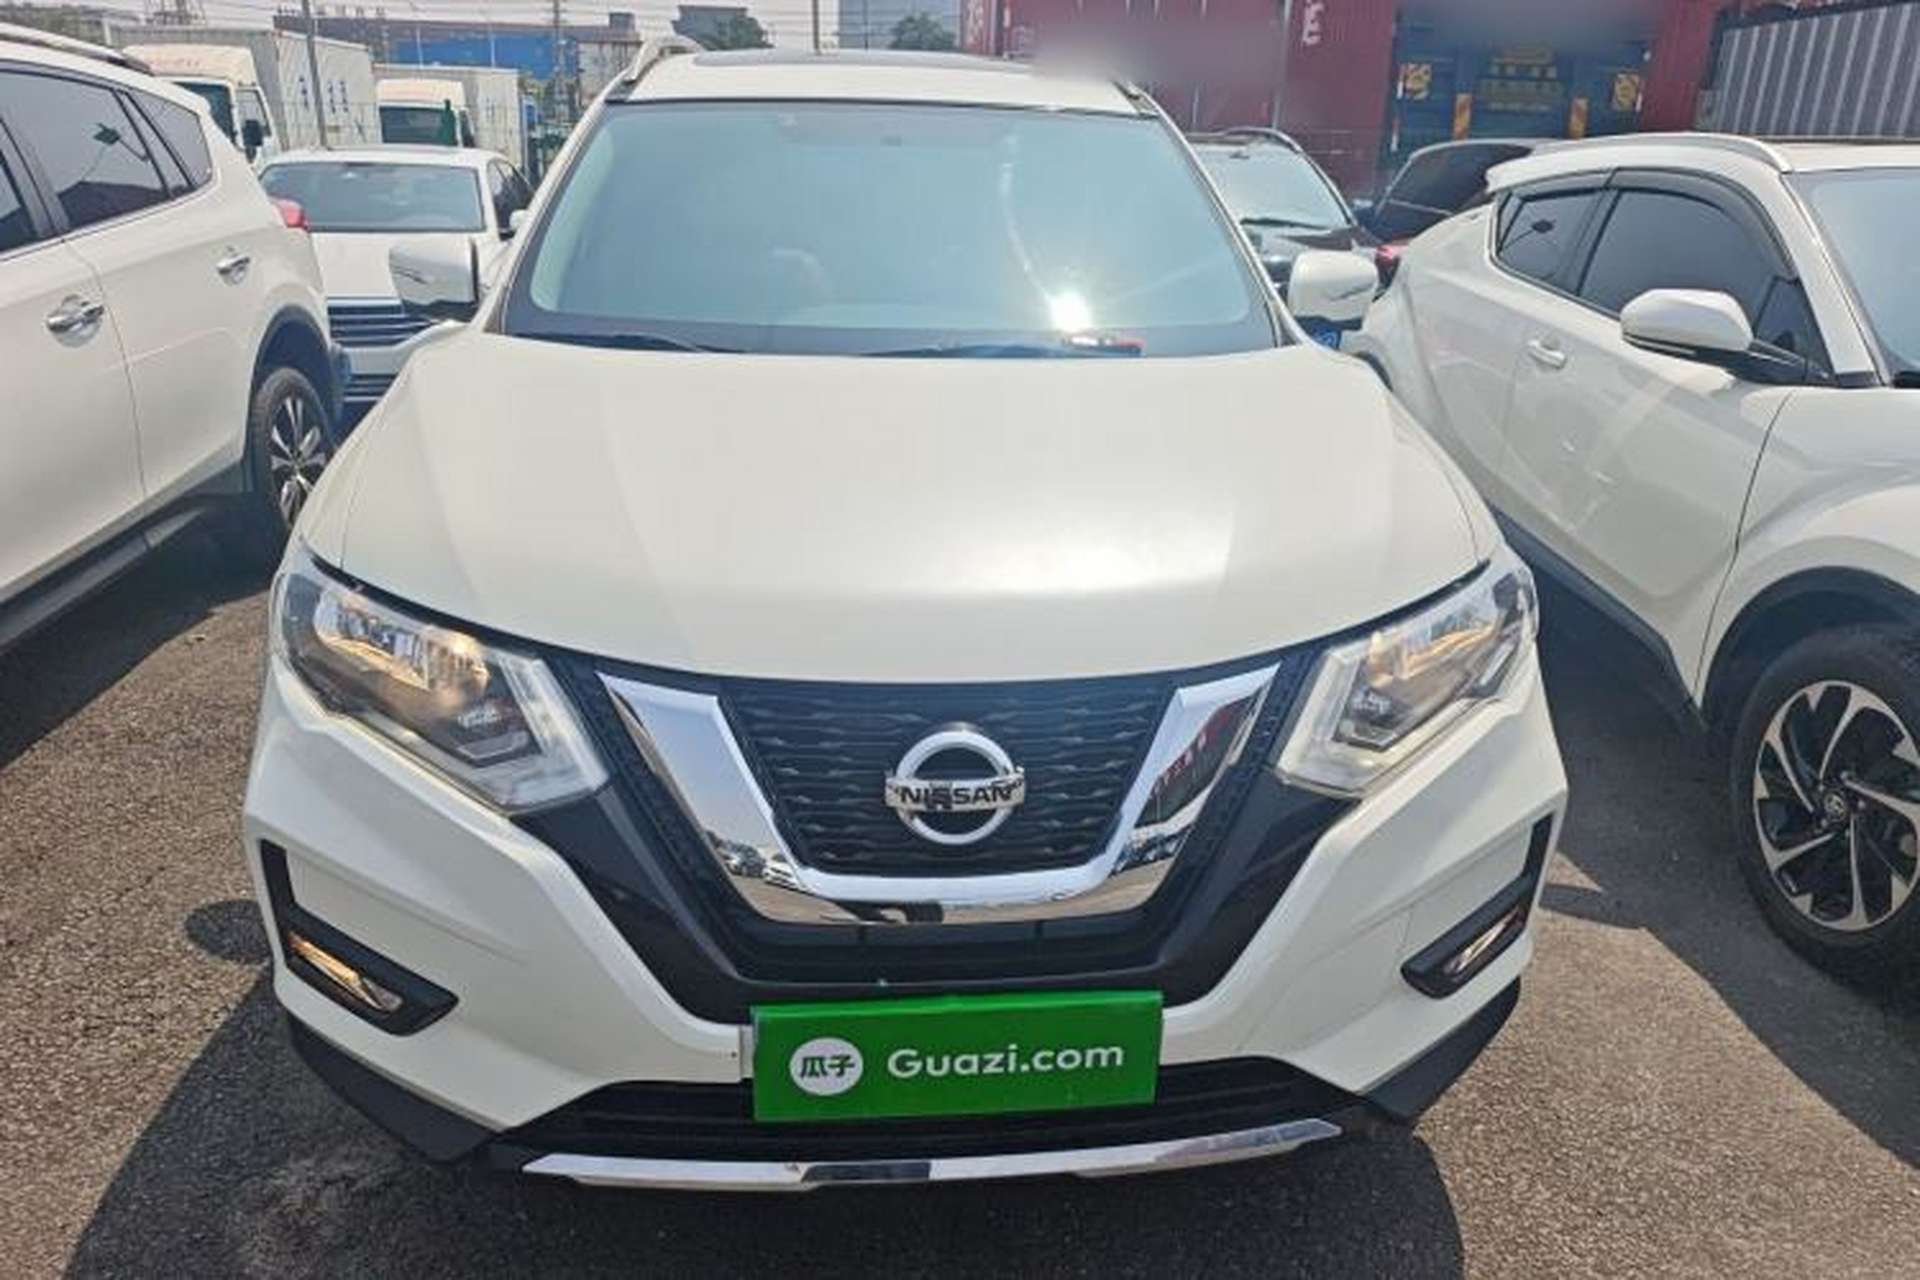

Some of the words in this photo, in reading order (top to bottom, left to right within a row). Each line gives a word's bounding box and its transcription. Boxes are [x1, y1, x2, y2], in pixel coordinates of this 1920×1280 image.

[898, 784, 1013, 805] NISSAN
[799, 1053, 857, 1078] 瓜子
[887, 1043, 1124, 1078] Guazi.com
